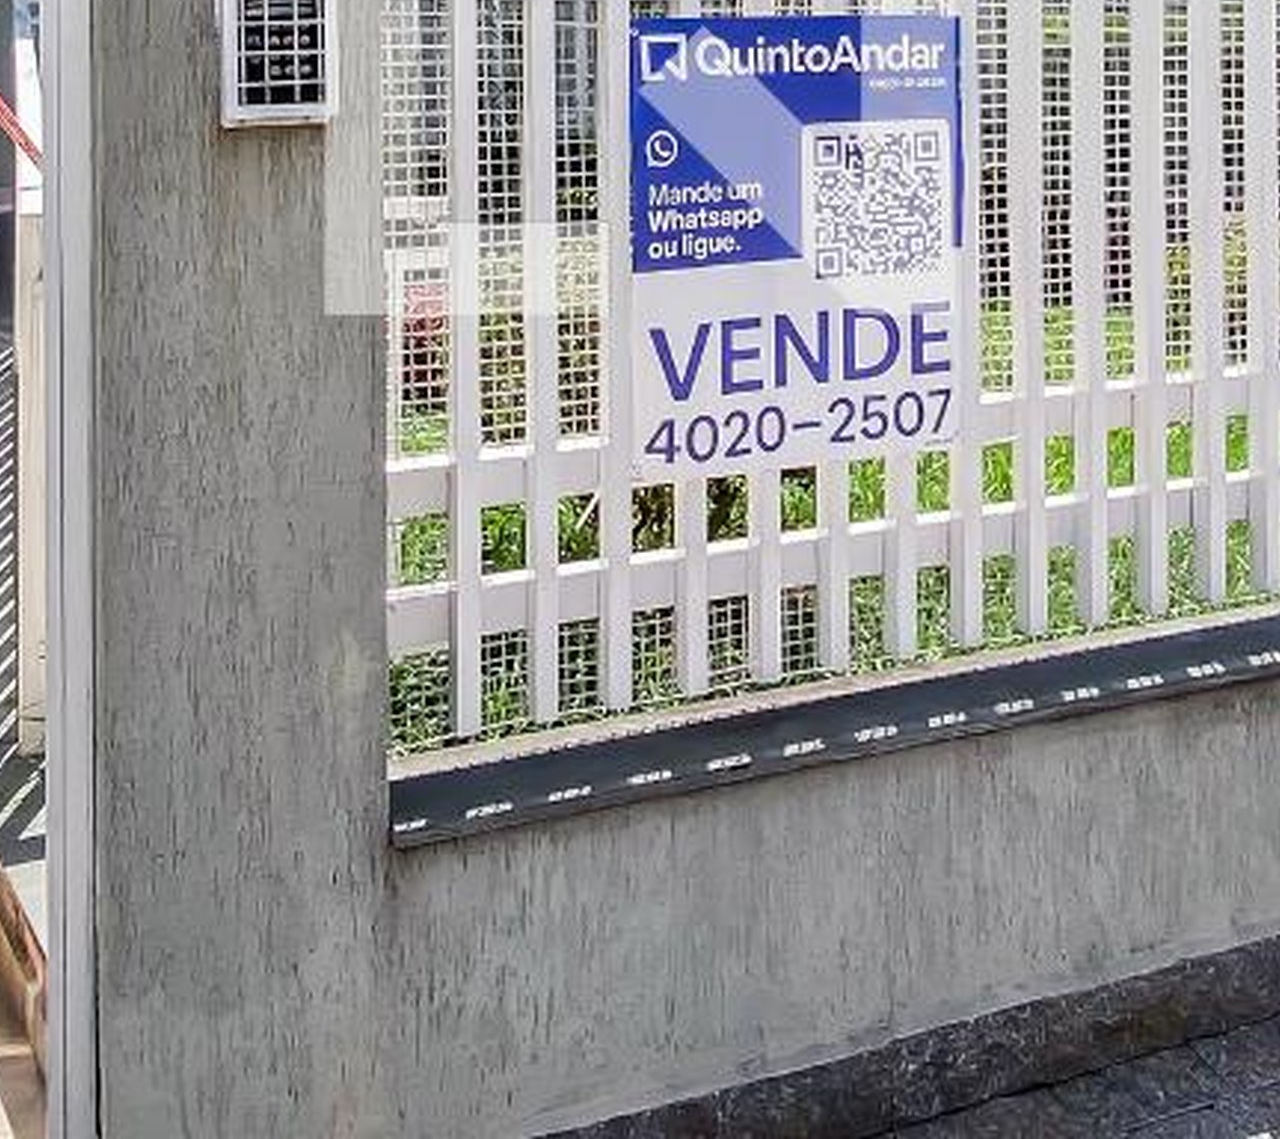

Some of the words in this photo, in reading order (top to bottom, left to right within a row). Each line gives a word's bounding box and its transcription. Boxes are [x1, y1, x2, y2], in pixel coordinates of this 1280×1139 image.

[694, 33, 946, 77] QuintoAndar
[648, 184, 722, 206] Mande
[728, 182, 762, 203] um
[648, 208, 764, 233] Whatsapp
[648, 240, 678, 259] ou
[681, 232, 741, 259] ligue.
[649, 301, 951, 402] VENDE
[644, 389, 953, 464] 4020-2507
